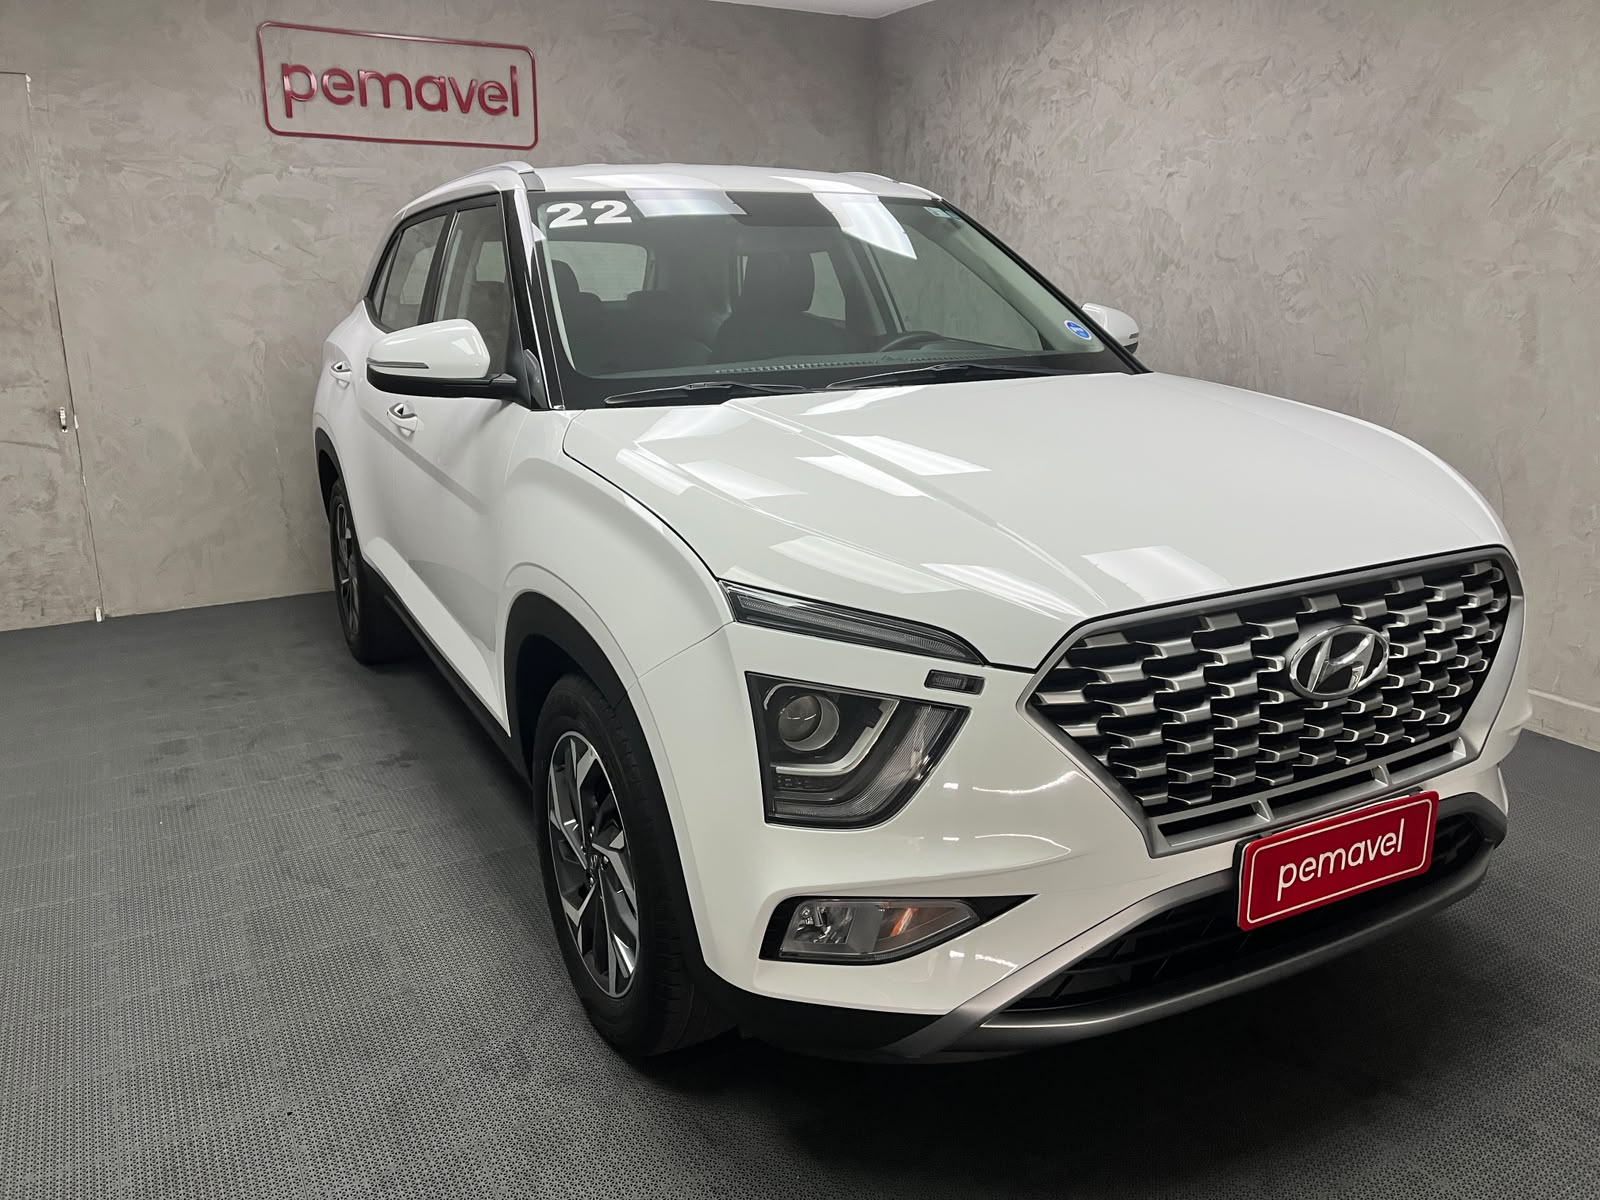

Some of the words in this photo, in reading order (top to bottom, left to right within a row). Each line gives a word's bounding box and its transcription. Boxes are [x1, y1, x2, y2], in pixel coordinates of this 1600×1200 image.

[281, 63, 520, 118] pemavel
[546, 200, 632, 228] 22
[1277, 818, 1405, 901] pemavel
